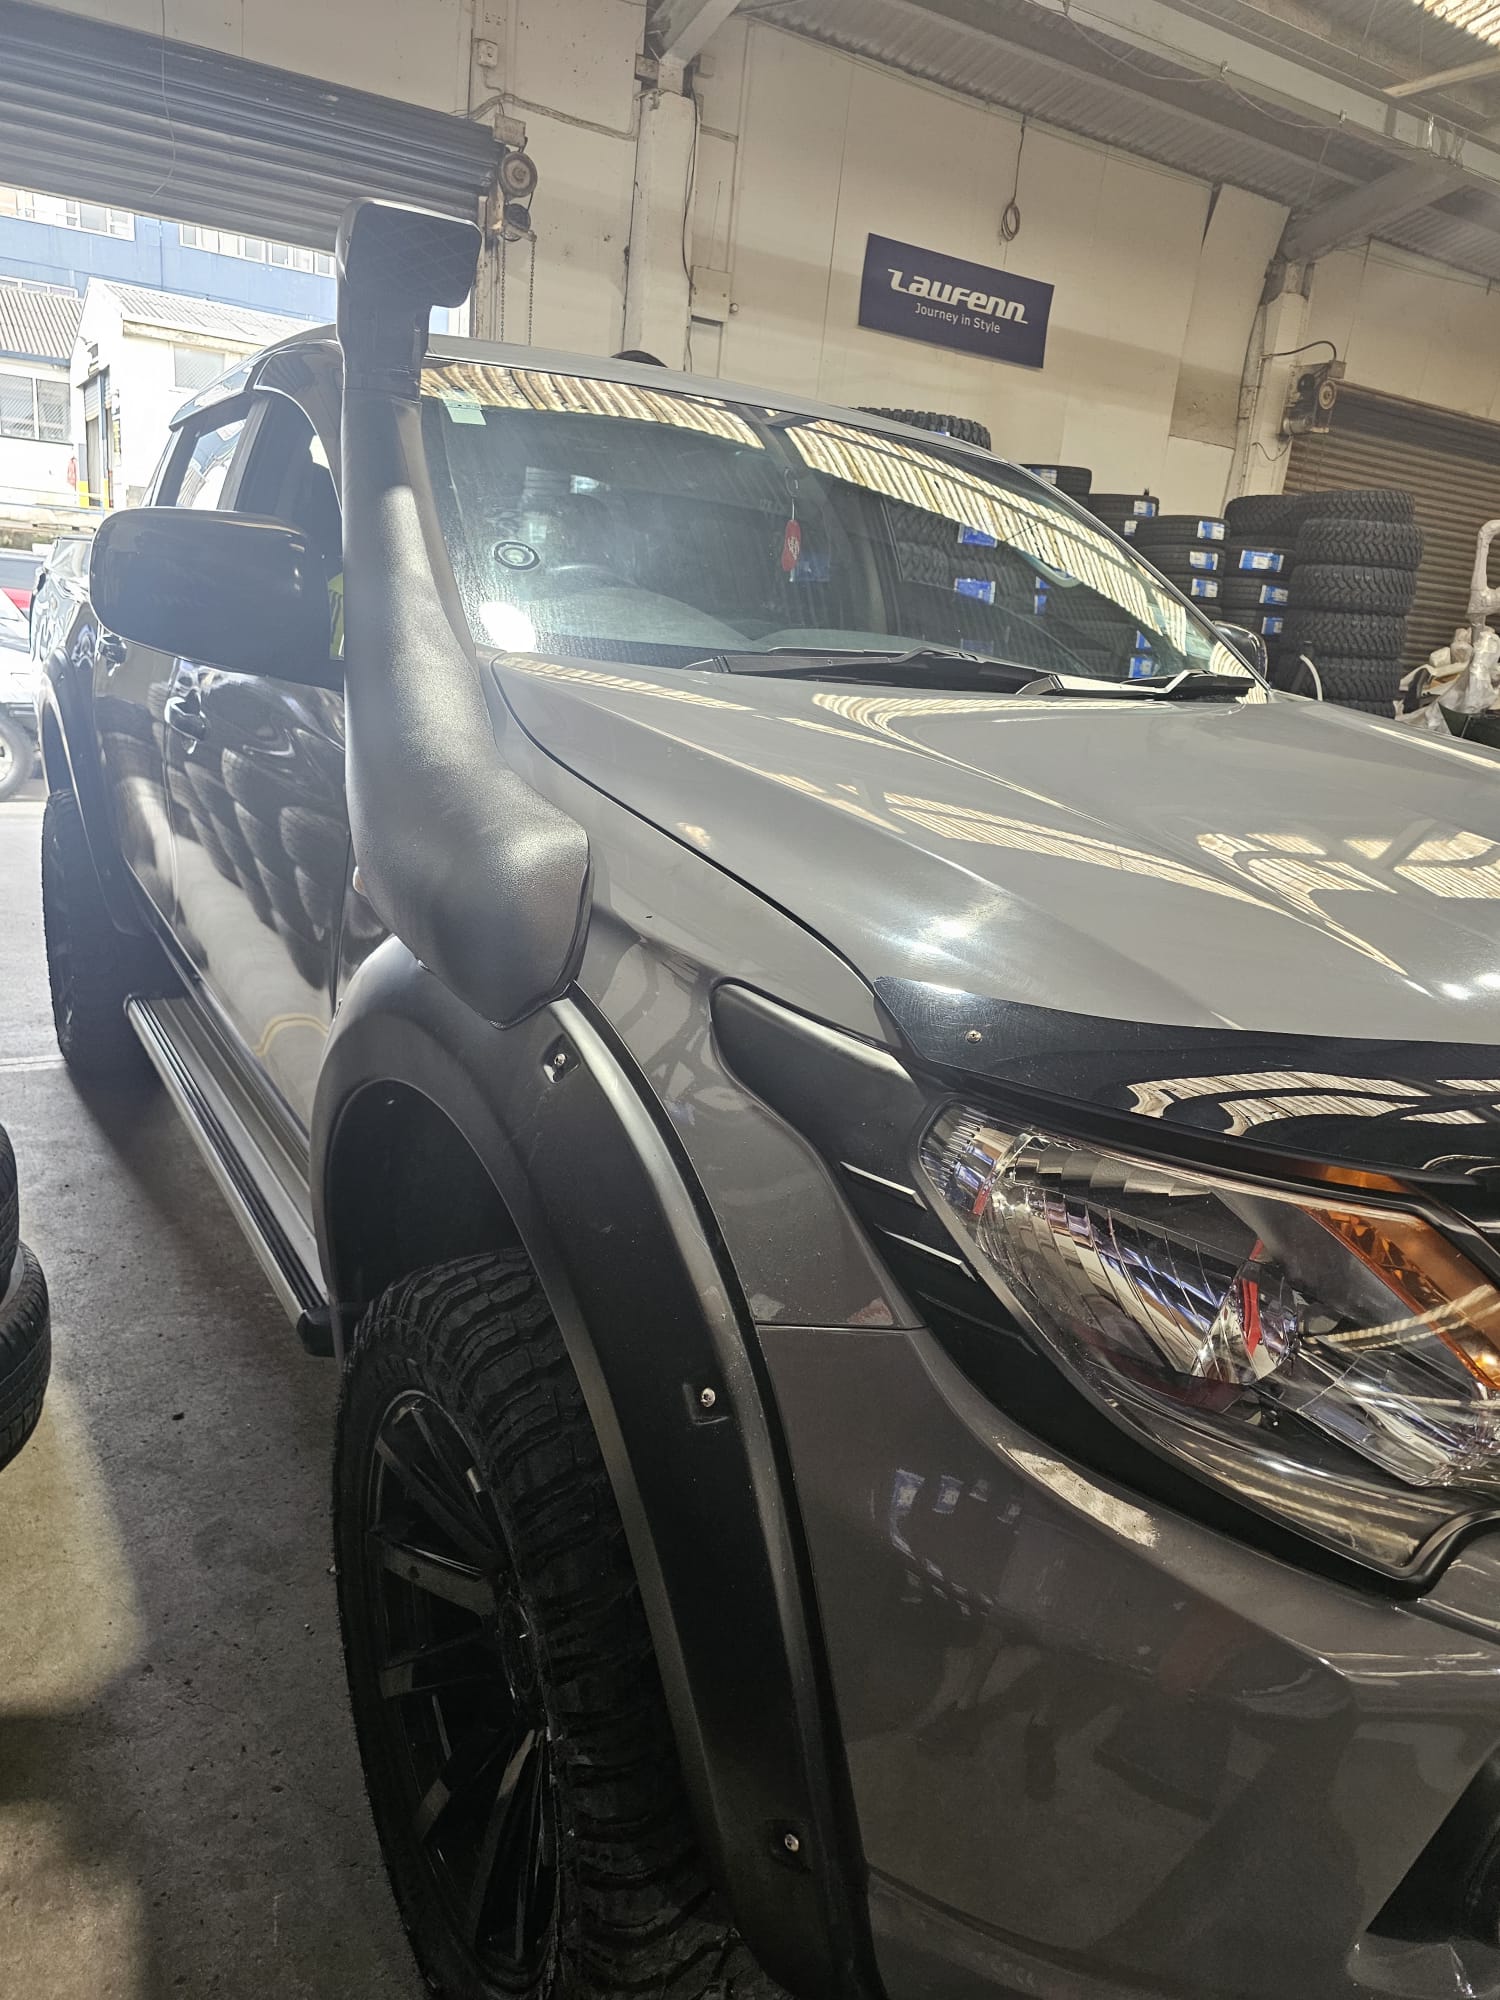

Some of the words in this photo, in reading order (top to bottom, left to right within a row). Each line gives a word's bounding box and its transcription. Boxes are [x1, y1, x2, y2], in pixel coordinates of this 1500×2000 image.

[888, 268, 1028, 324] Laufenn
[915, 302, 959, 325] Journey
[961, 314, 971, 326] in
[973, 317, 1001, 334] Style
